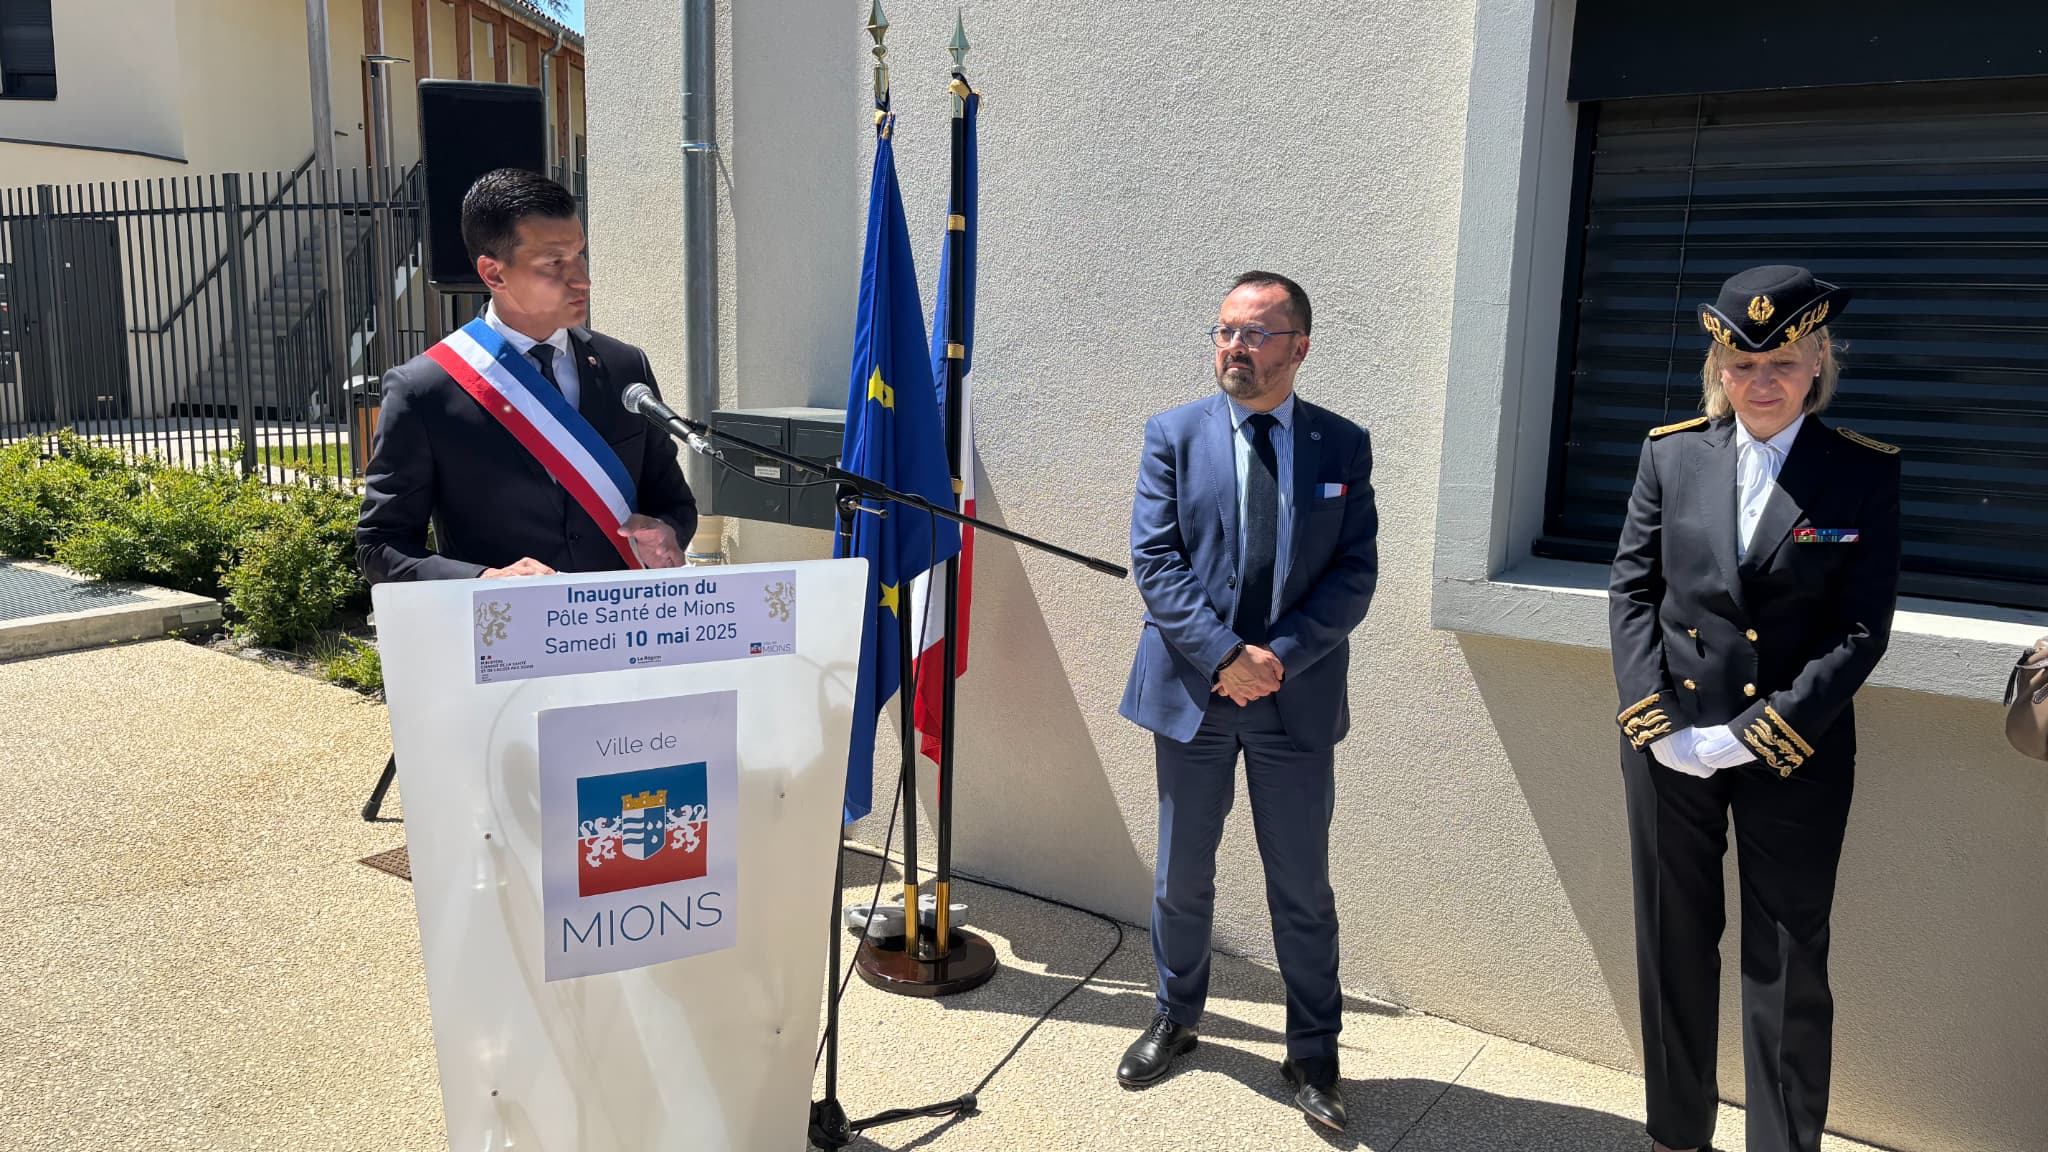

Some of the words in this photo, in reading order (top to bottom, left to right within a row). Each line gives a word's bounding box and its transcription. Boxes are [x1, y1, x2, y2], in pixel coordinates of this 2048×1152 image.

[567, 581, 689, 605] Inauguration
[695, 578, 717, 595] du
[547, 608, 589, 627] Pôle
[595, 603, 649, 624] Santé
[655, 602, 677, 619] de
[684, 600, 735, 617] Mions
[545, 632, 616, 655] Samedi
[625, 630, 648, 648] 10
[656, 626, 690, 645] mai
[695, 622, 737, 642] 2025
[596, 737, 643, 757] Ville
[650, 732, 677, 751] de
[563, 891, 722, 953] MIONS
